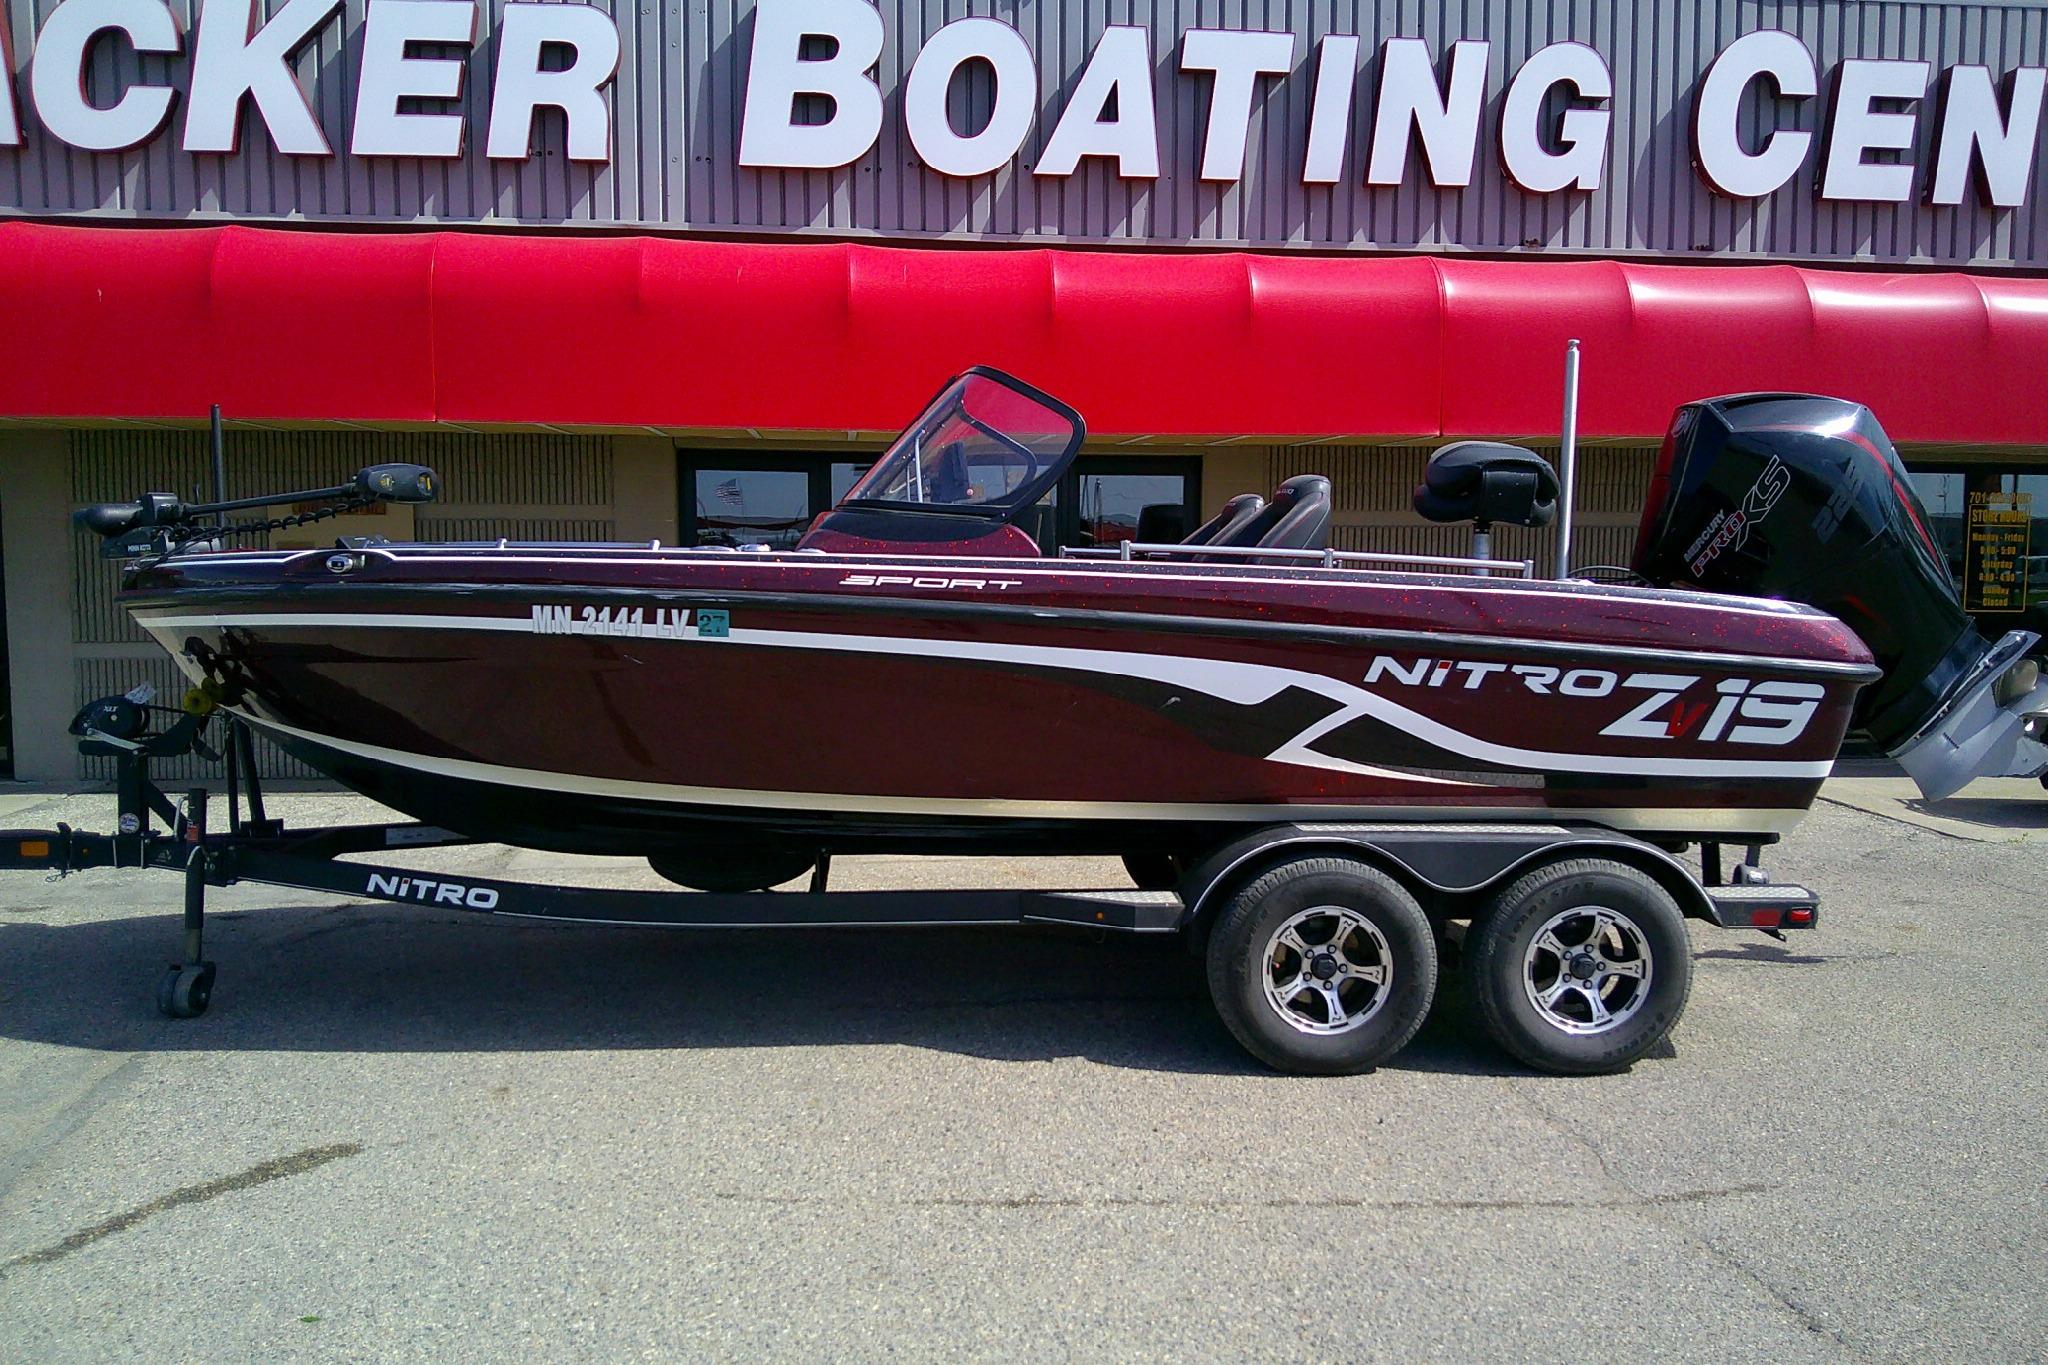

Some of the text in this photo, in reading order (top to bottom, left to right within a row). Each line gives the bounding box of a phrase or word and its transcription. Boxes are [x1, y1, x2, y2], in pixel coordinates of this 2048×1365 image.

[0, 0, 2046, 207] CKER BOATING CEN
[1684, 509, 1726, 562] MERCURY
[839, 575, 1023, 590] SPORT
[532, 605, 690, 637] MN 2141 LV
[699, 614, 726, 633] 27
